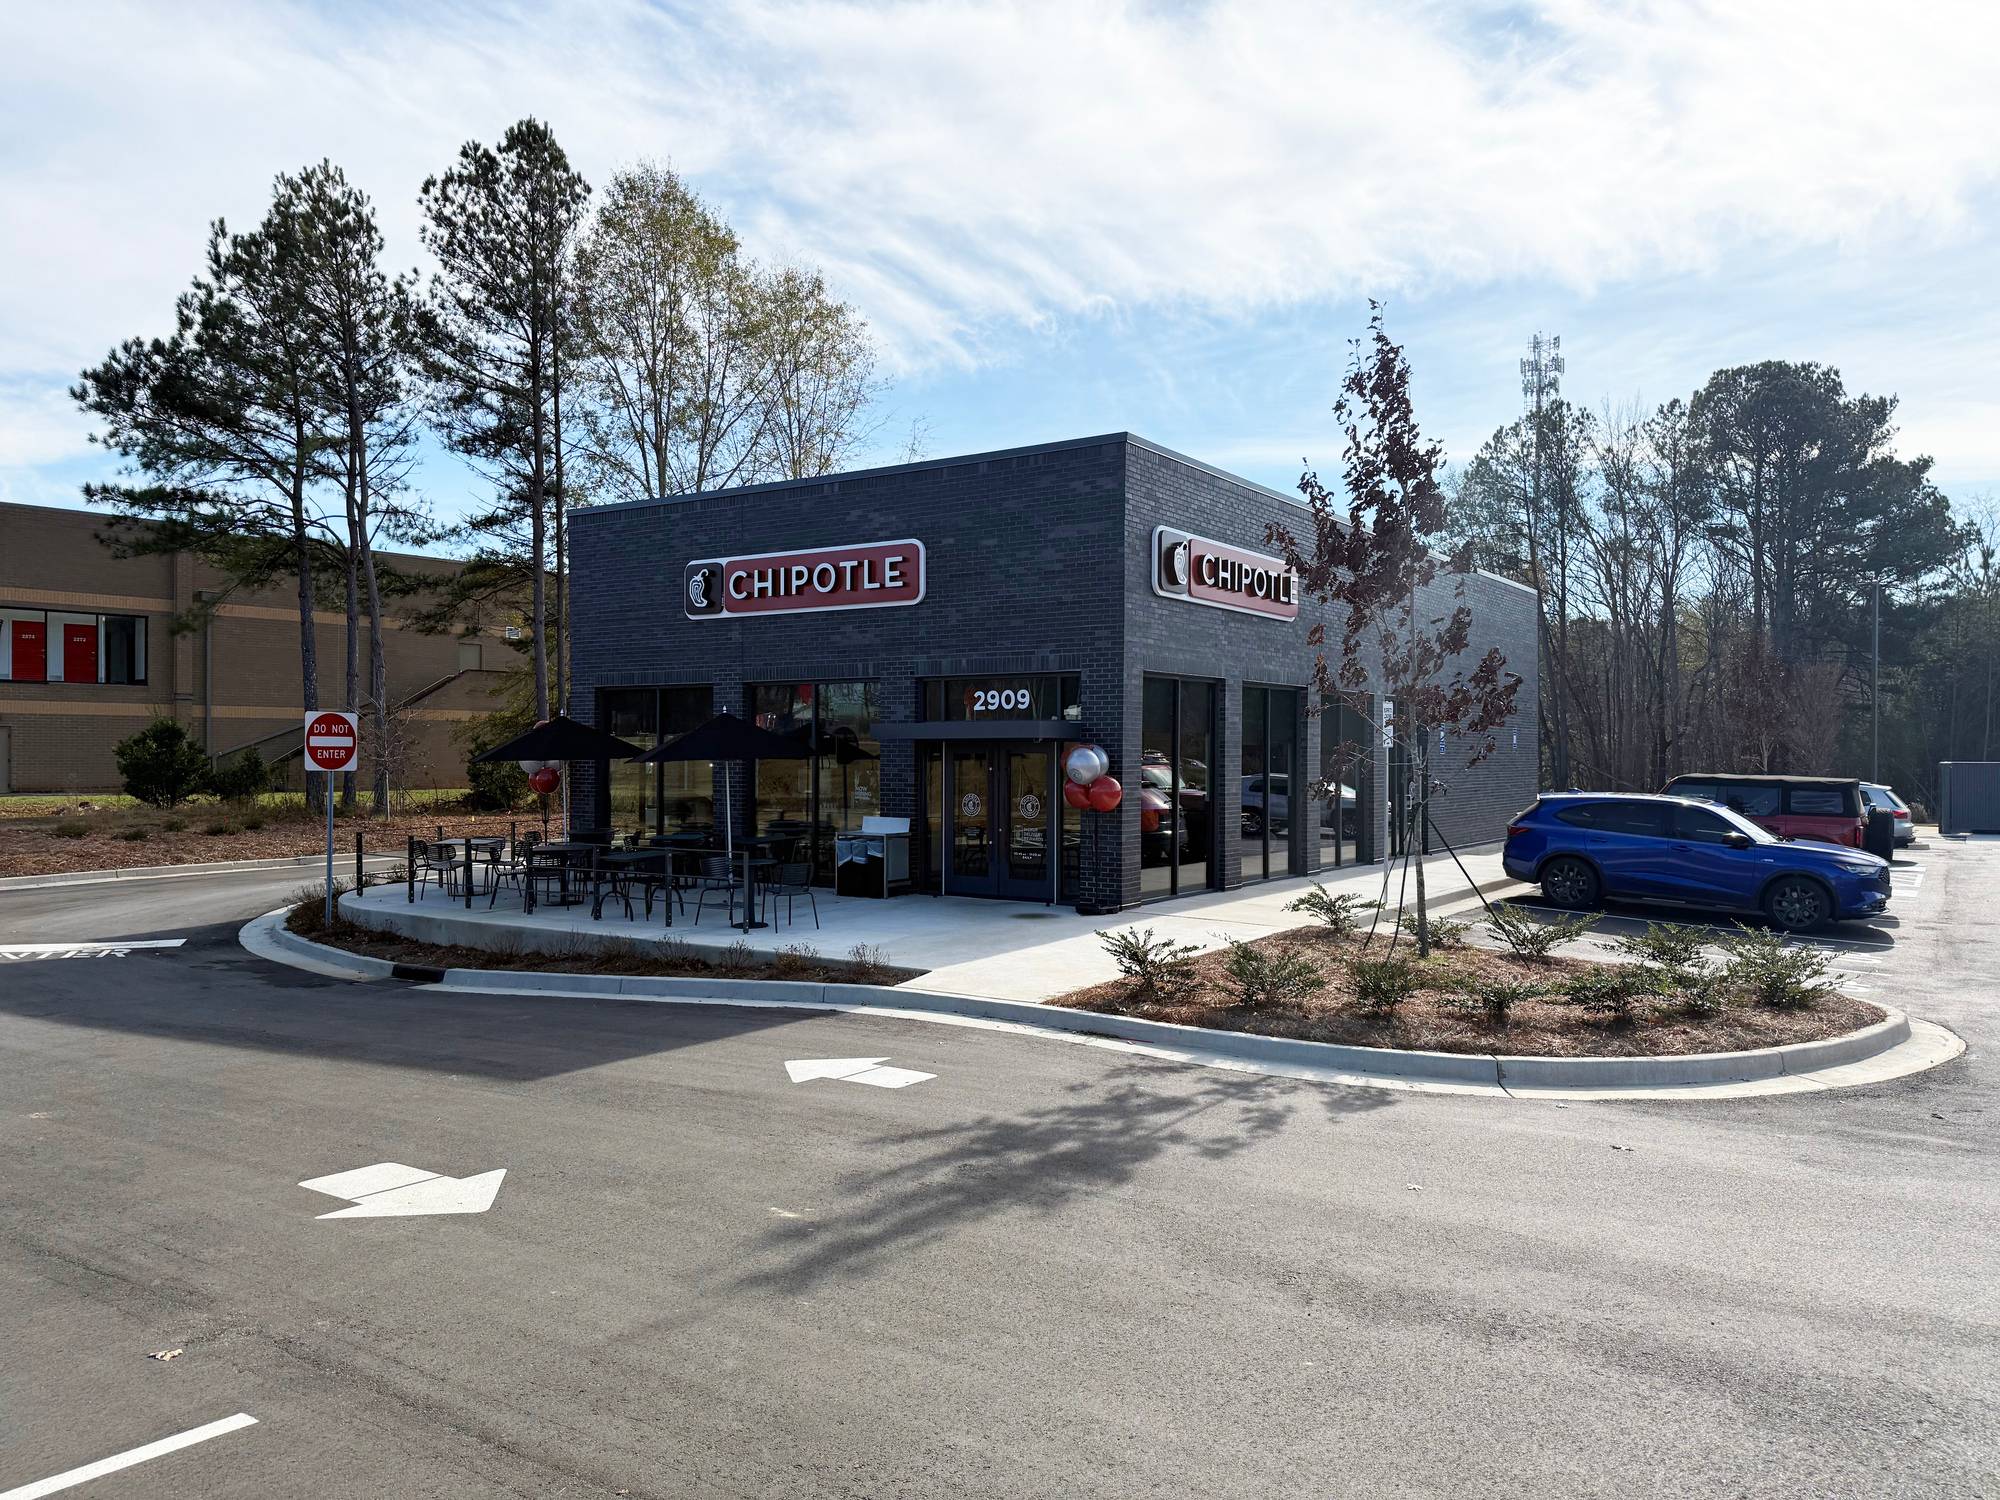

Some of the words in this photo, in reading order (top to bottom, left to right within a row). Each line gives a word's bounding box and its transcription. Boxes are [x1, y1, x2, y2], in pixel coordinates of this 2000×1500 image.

[728, 556, 904, 600] CHIPOTLE
[1202, 552, 1299, 605] CHIPOTLE
[973, 689, 1030, 711] 2909
[313, 724, 327, 734] DO
[331, 724, 349, 734] NOT
[317, 749, 346, 759] ENTER
[0, 949, 131, 959] NTER
